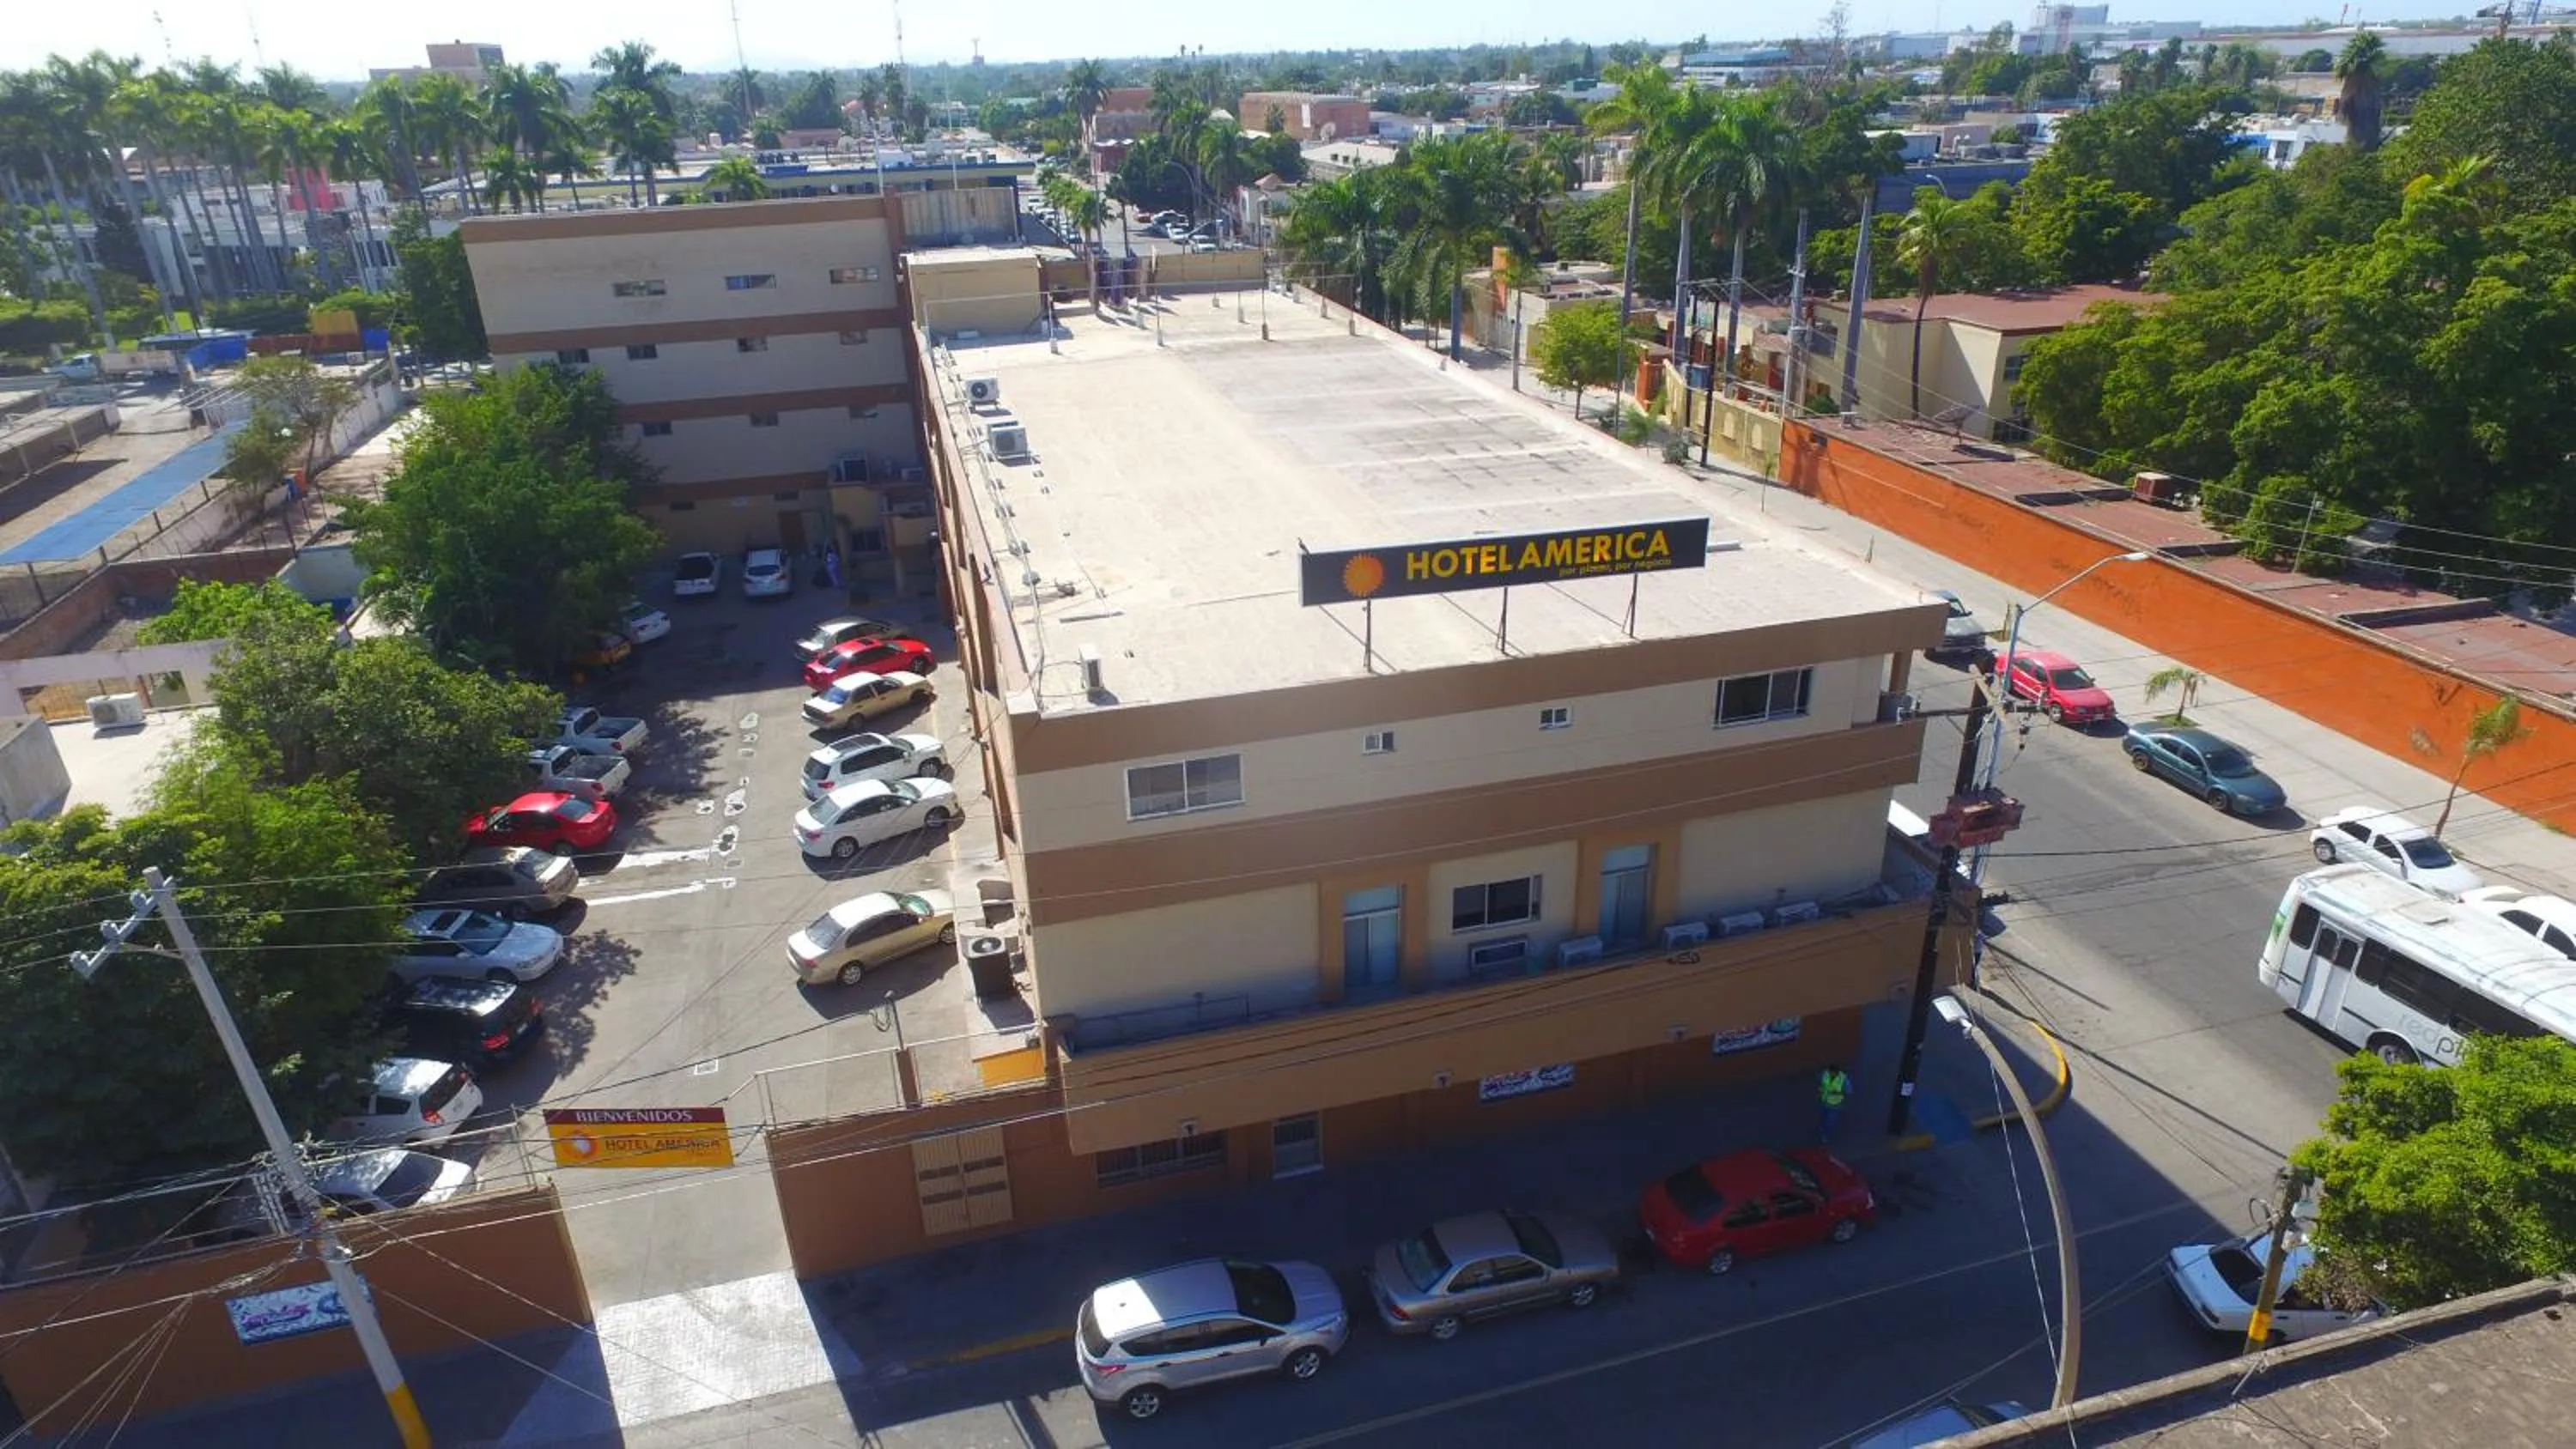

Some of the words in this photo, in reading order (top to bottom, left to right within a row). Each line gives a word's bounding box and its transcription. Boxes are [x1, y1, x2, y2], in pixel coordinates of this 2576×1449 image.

[1406, 544, 1512, 579] HOTEL
[1518, 530, 1670, 569] AMERICA
[575, 1110, 693, 1123] BIENVENIDOS
[605, 1138, 649, 1151] HOTEL
